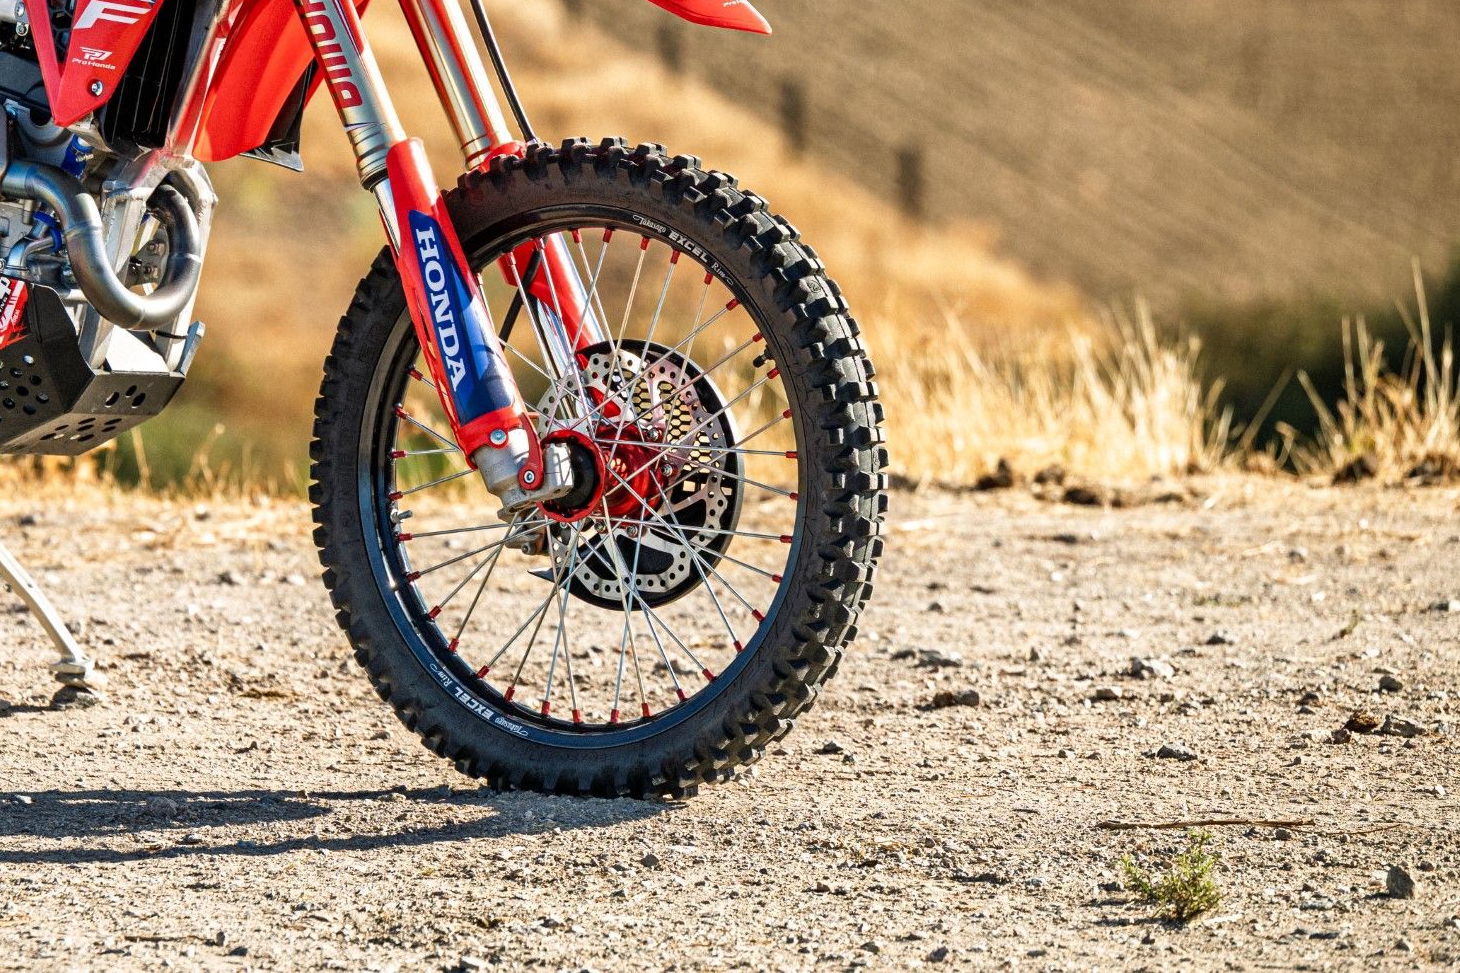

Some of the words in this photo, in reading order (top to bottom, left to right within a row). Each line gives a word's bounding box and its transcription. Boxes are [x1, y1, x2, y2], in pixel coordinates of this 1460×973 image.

[668, 230, 708, 263] EXCEL
[416, 226, 467, 393] HONDA
[454, 686, 495, 720] EXCEL
